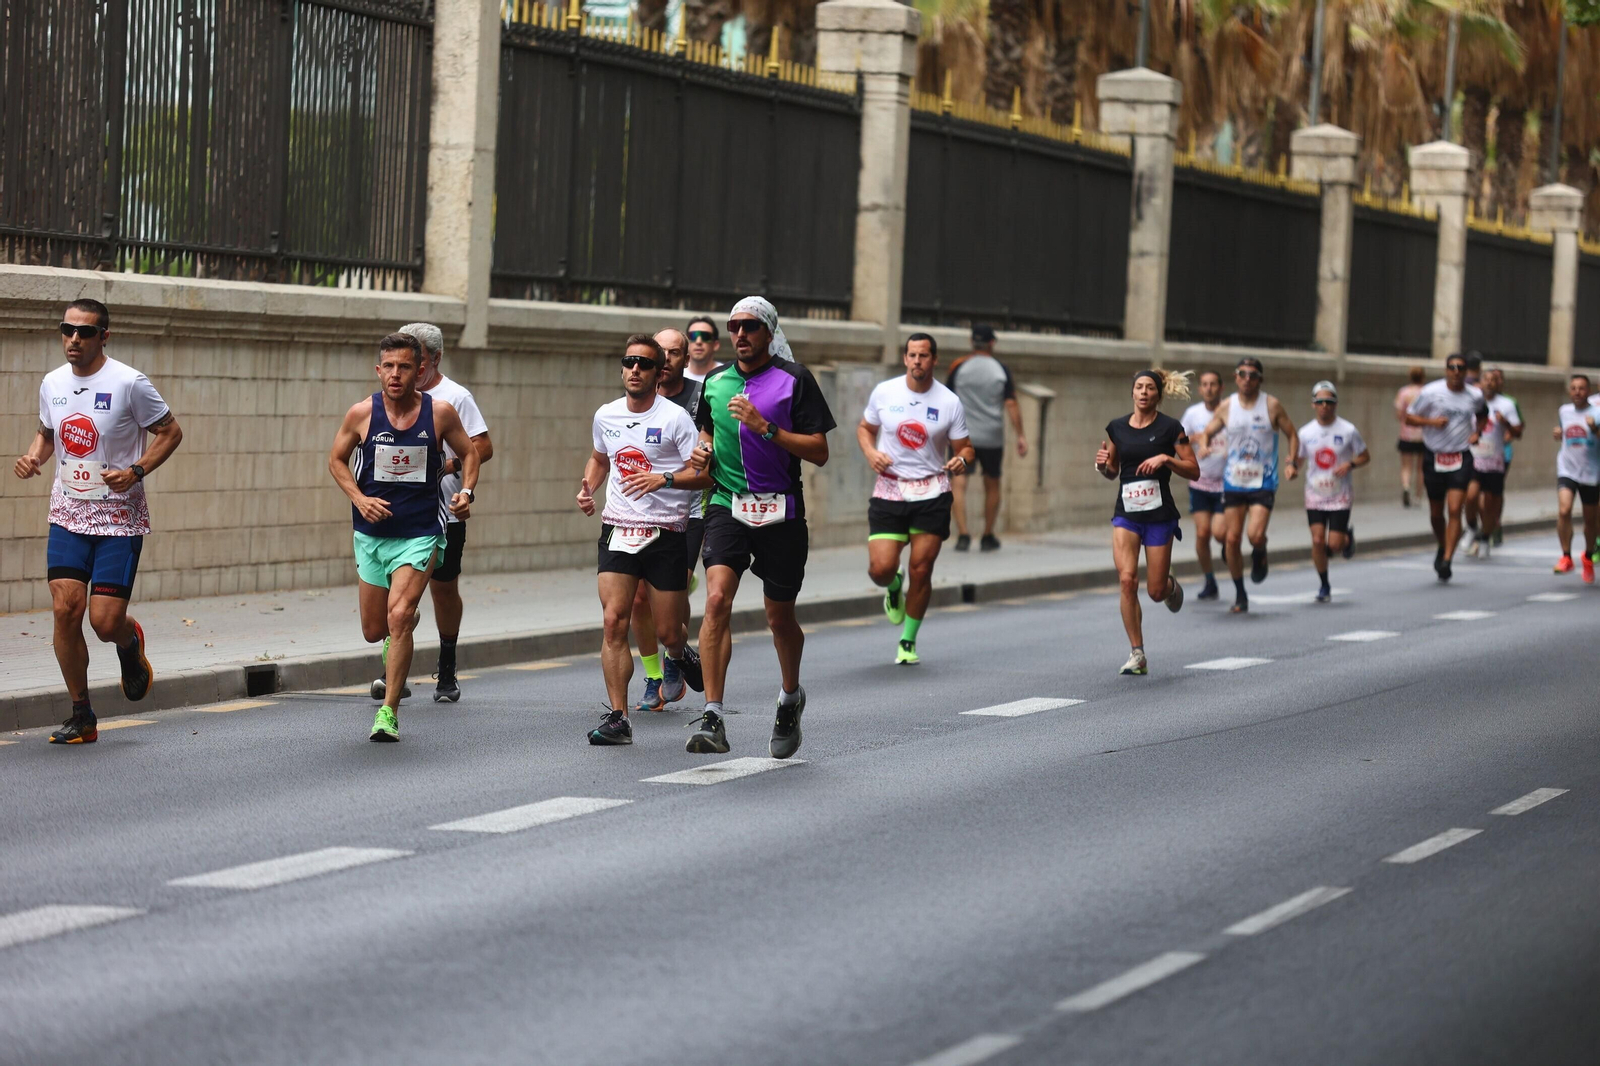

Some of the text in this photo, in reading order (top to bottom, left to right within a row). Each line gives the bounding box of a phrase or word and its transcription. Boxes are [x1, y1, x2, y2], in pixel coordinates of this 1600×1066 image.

[94, 401, 108, 409] AXA
[64, 423, 94, 440] PONLE
[63, 432, 92, 448] FRENO
[645, 435, 659, 443] AXA
[392, 456, 410, 465] 54
[619, 454, 647, 469] PONLE
[73, 470, 90, 481] 30
[1128, 487, 1155, 499] 1347
[741, 502, 778, 513] 1153
[621, 527, 653, 538] 1108
